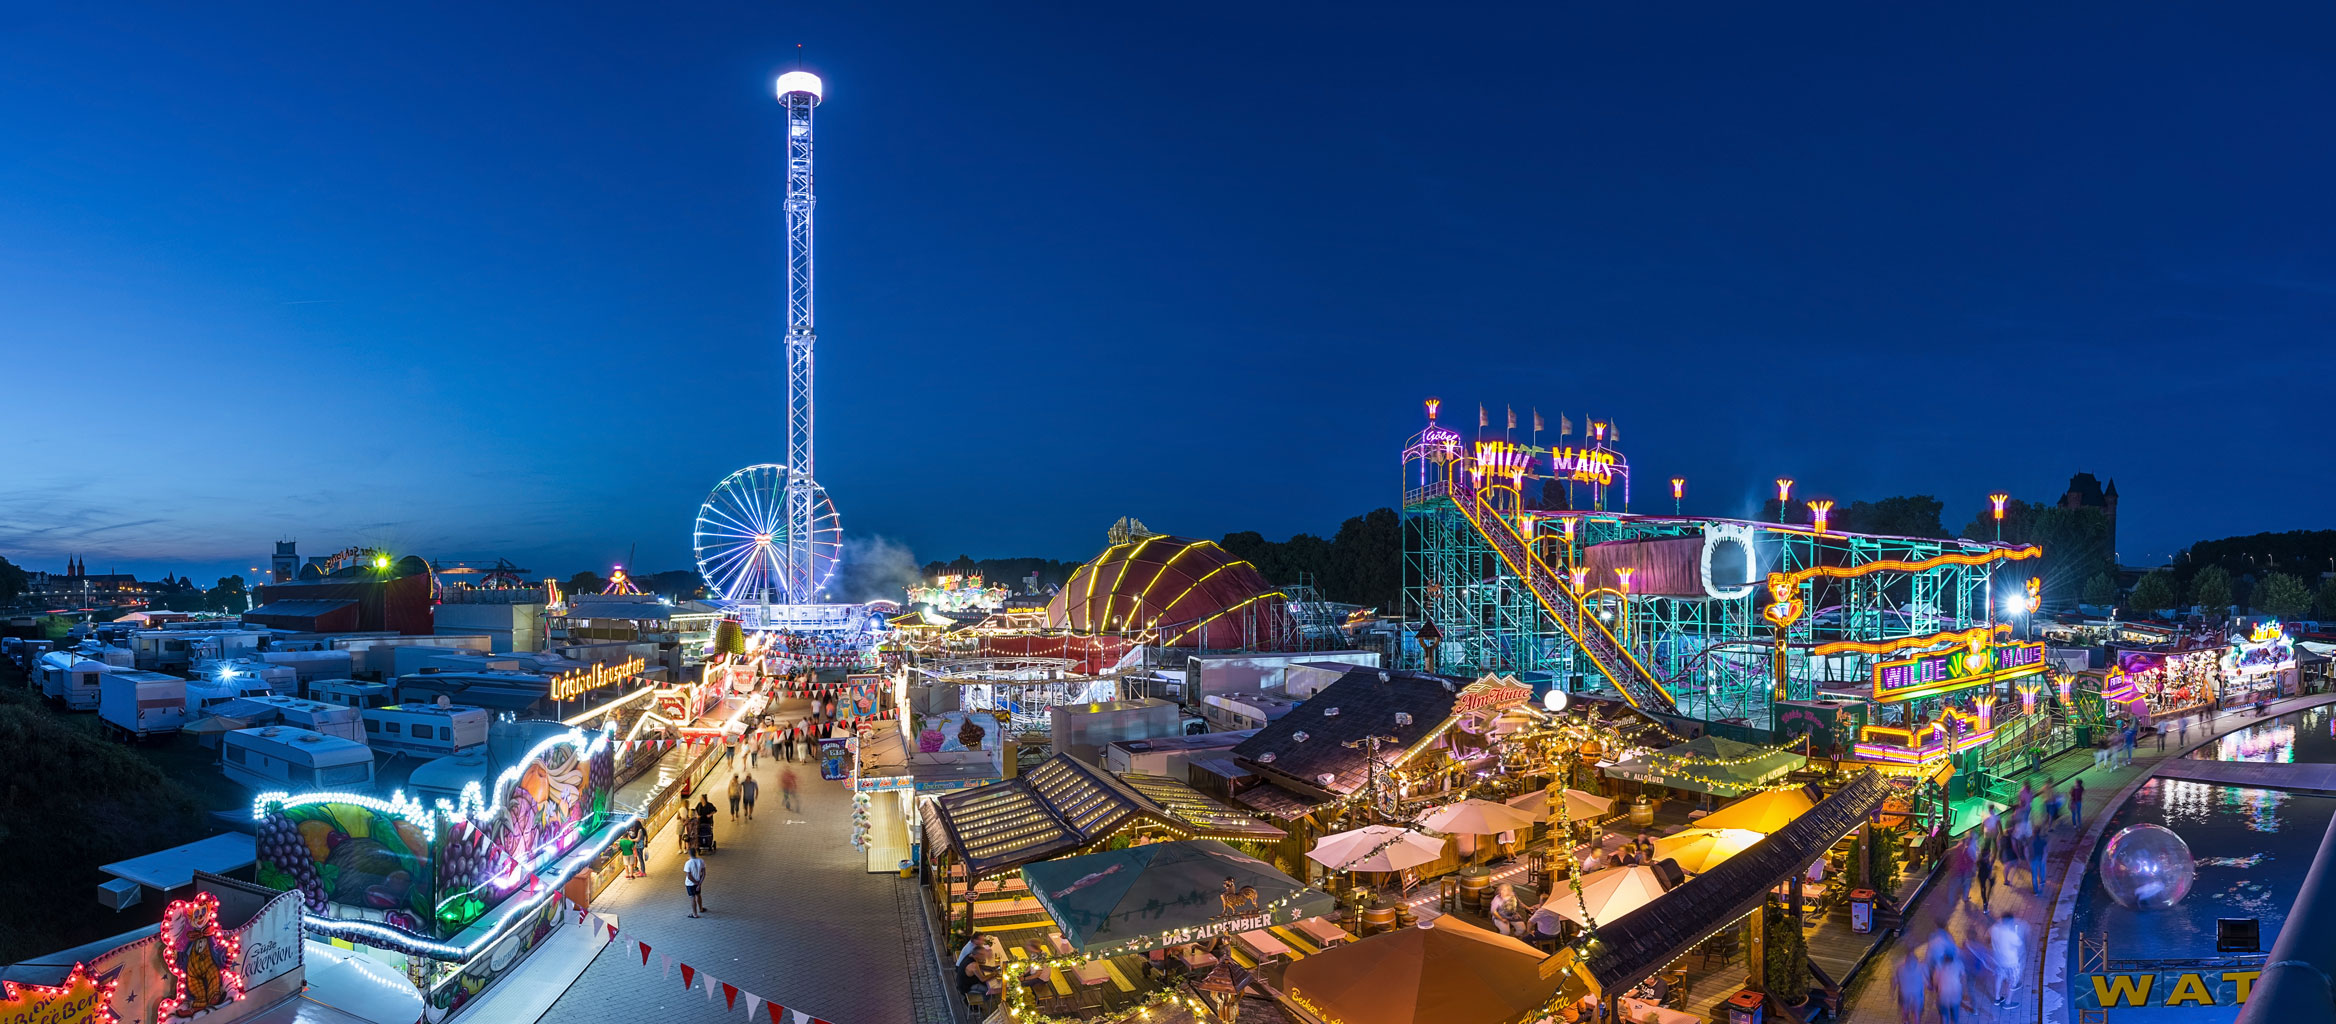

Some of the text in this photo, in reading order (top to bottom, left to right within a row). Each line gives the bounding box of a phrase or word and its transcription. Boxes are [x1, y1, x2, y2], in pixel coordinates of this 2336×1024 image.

[1475, 441, 1614, 486] WILDE MAUS
[551, 666, 596, 702] Original
[1883, 646, 2042, 689] WILDE MAUS
[1633, 772, 1665, 785] ALLGÄUER
[1162, 913, 1272, 946] DAS ALPENBIER
[241, 945, 293, 980] Leckereien
[251, 940, 277, 958] Süße
